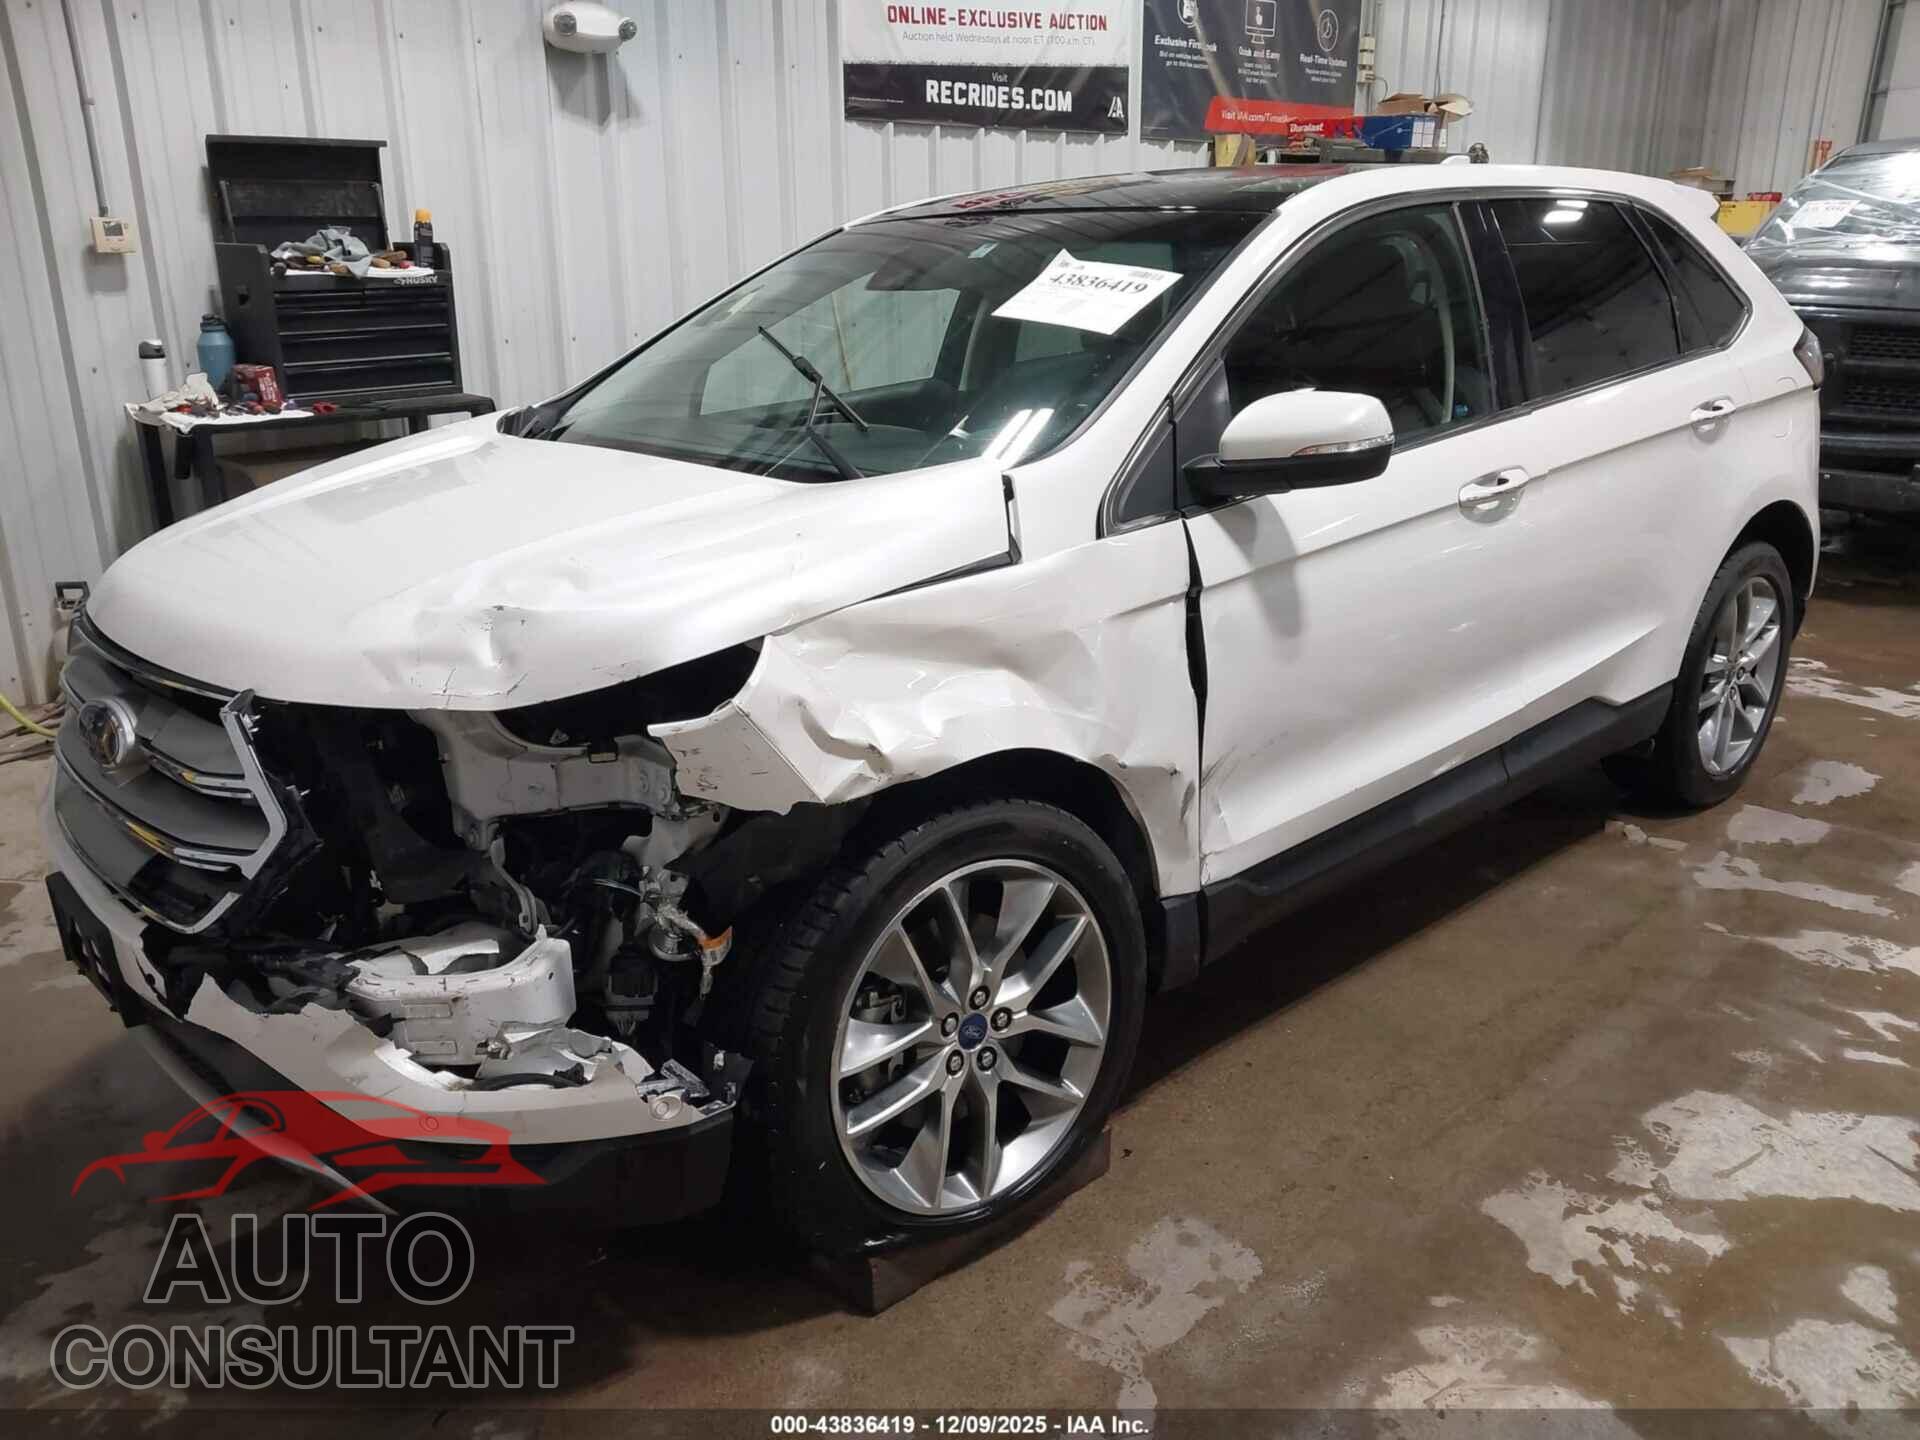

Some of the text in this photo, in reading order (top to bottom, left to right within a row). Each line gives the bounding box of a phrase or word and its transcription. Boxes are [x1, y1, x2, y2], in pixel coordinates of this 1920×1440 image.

[887, 5, 1108, 31] ONLINE-EXCLUSIVE AUCTION
[902, 31, 935, 42] Auction
[1154, 34, 1187, 48] Exclusive
[991, 71, 1008, 83] Visit
[925, 79, 1073, 113] RECRIDES.COM
[1289, 122, 1325, 133] Duralast
[1050, 273, 1149, 294] 43836419
